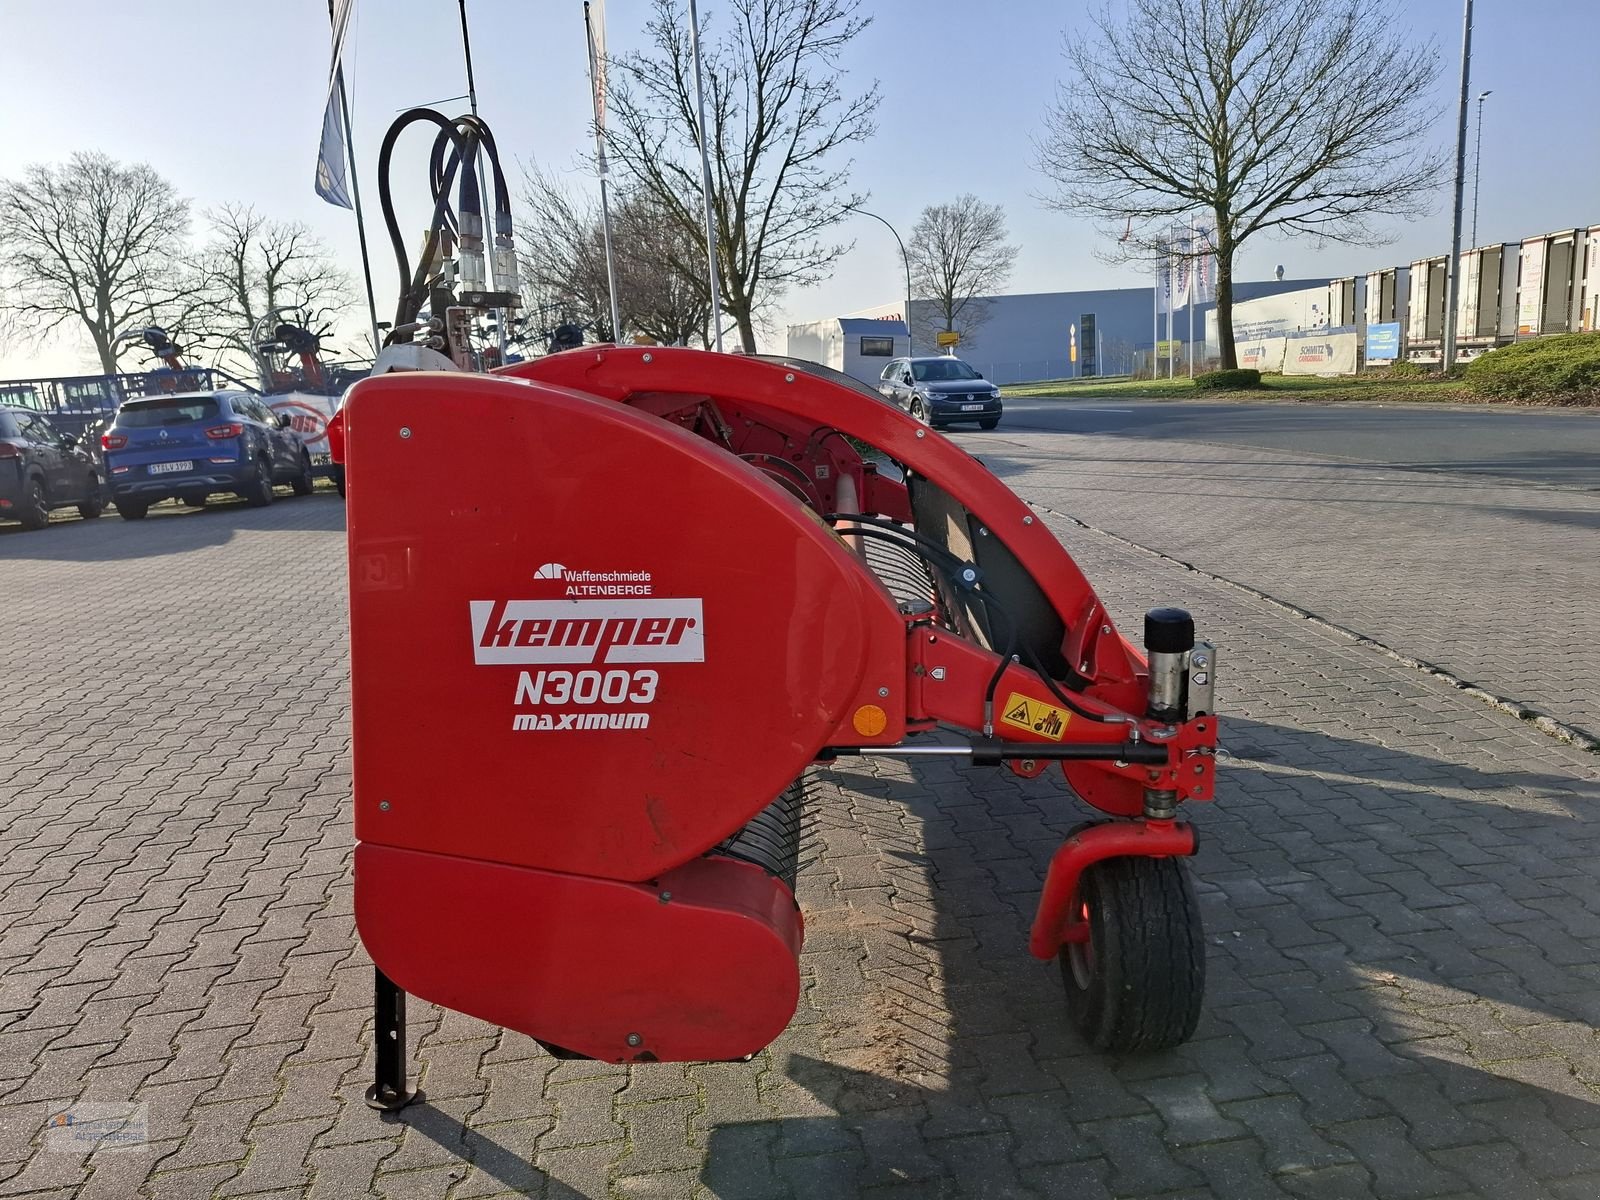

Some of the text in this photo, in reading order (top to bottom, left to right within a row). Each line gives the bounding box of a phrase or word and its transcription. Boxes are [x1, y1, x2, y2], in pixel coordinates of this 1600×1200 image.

[1300, 345, 1324, 355] SCHMITZ
[564, 569, 651, 582] Waffenschmiede
[565, 585, 652, 596] ALTENBERGE
[479, 600, 697, 664] kemper
[513, 669, 659, 705] N3003
